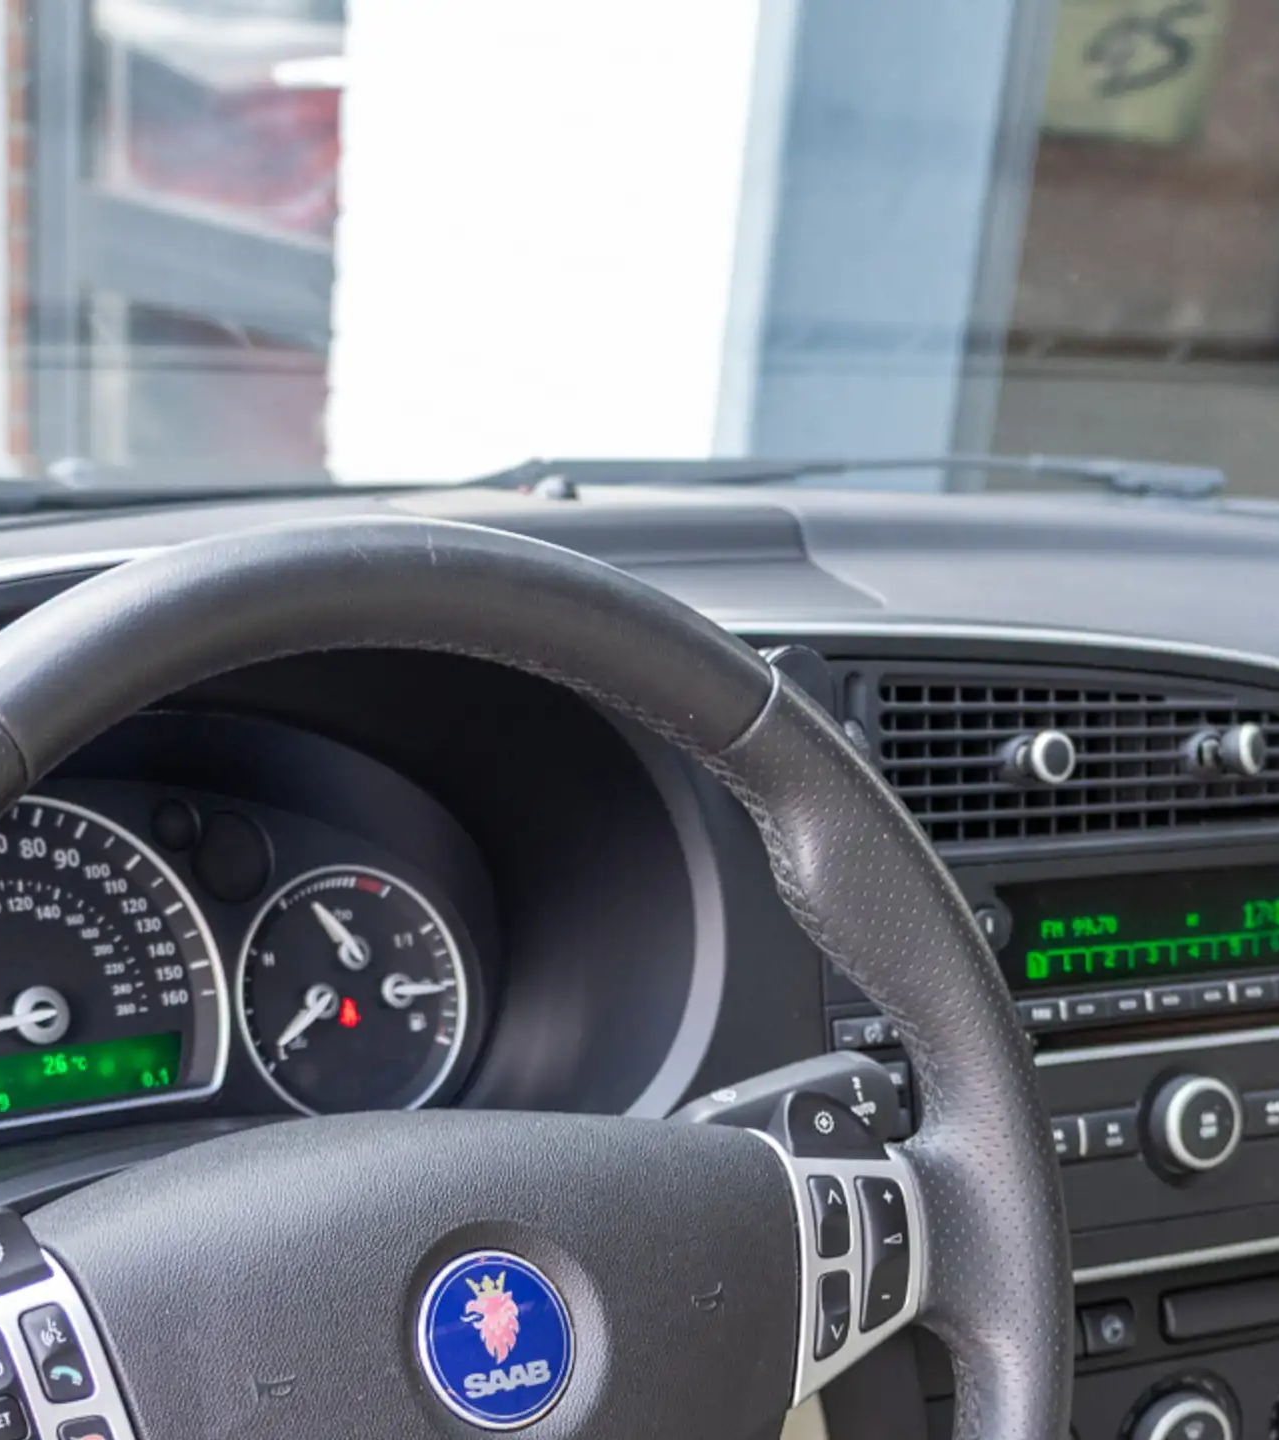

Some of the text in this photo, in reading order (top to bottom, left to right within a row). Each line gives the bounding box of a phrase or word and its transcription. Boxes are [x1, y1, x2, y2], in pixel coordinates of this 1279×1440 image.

[20, 837, 47, 859] 80
[53, 849, 80, 869] 90
[83, 863, 111, 879] 100
[103, 878, 128, 895] 110
[7, 896, 34, 912] 120
[36, 904, 61, 921] 140
[121, 897, 147, 914] 120
[136, 917, 162, 933] 130
[148, 942, 175, 958] 140
[155, 965, 183, 981] 150
[161, 989, 188, 1006] 160
[42, 1053, 69, 1077] 26
[463, 1359, 552, 1400] SAAB
